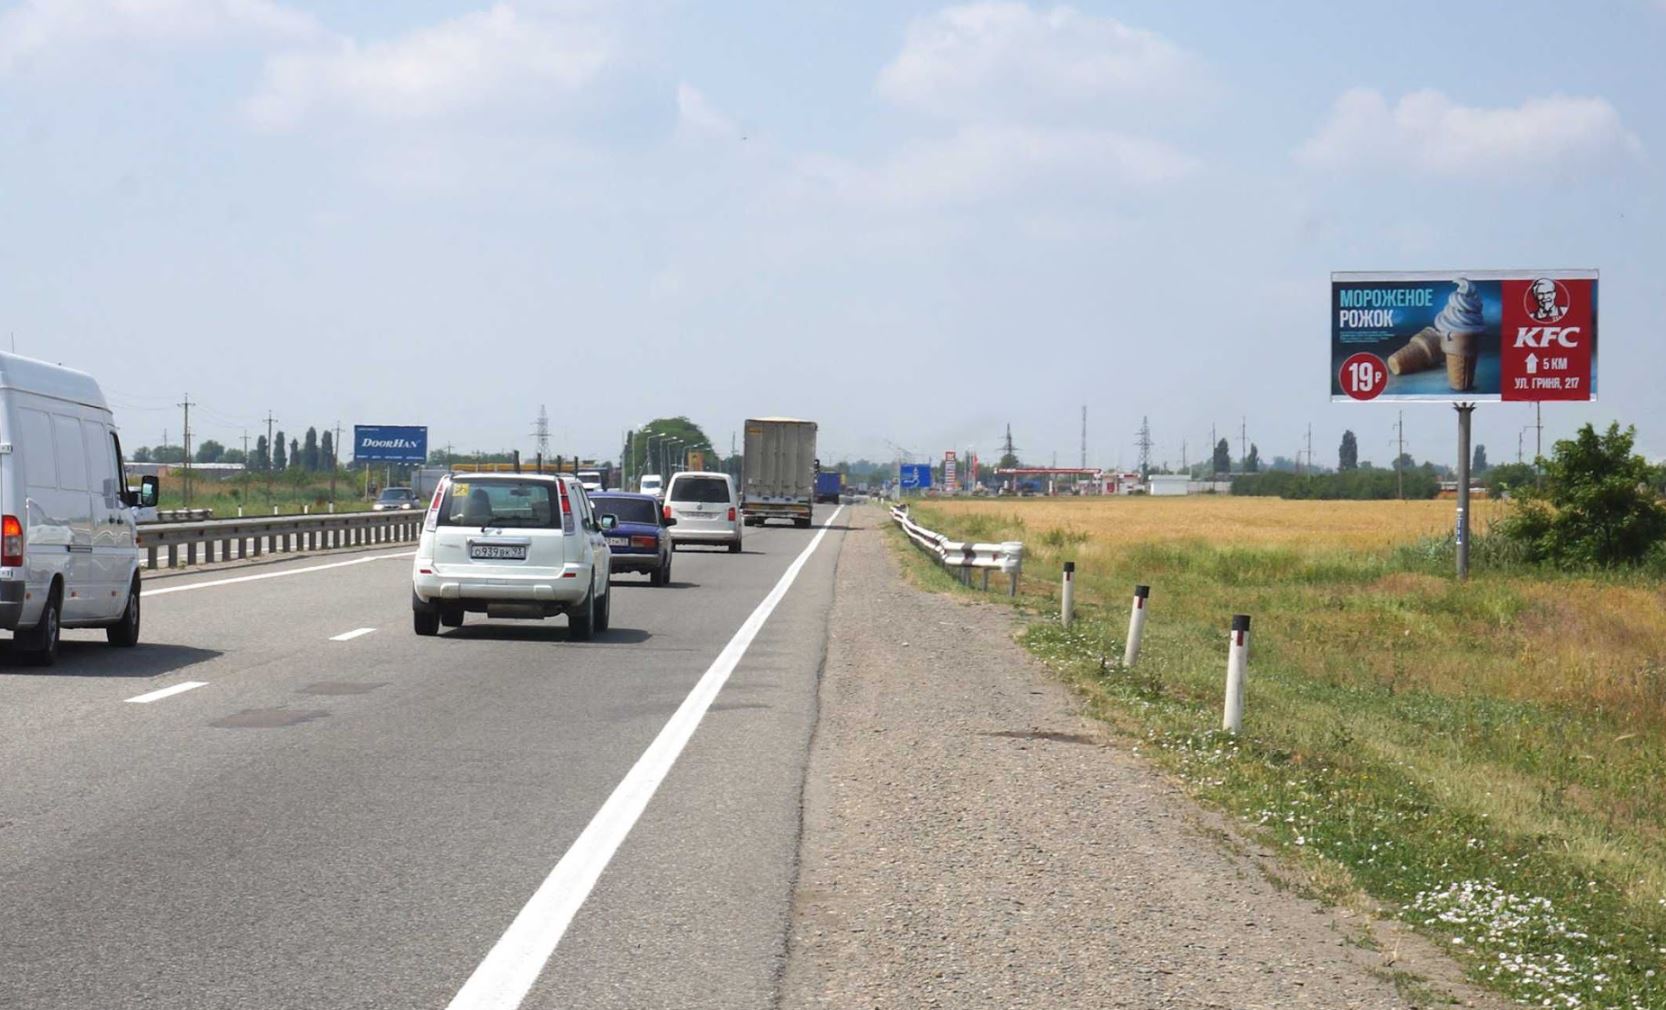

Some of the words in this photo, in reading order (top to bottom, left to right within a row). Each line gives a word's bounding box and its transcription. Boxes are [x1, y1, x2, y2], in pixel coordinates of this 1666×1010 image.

[1340, 288, 1433, 307] МОРОЖЕНОЕ
[1340, 309, 1393, 328] РОЖОК
[1513, 326, 1580, 348] KFC
[1543, 357, 1550, 370] 5
[1551, 357, 1568, 370] КМ
[1348, 362, 1374, 392] 19
[1514, 377, 1529, 389] УЛ.
[1565, 376, 1580, 389] 217
